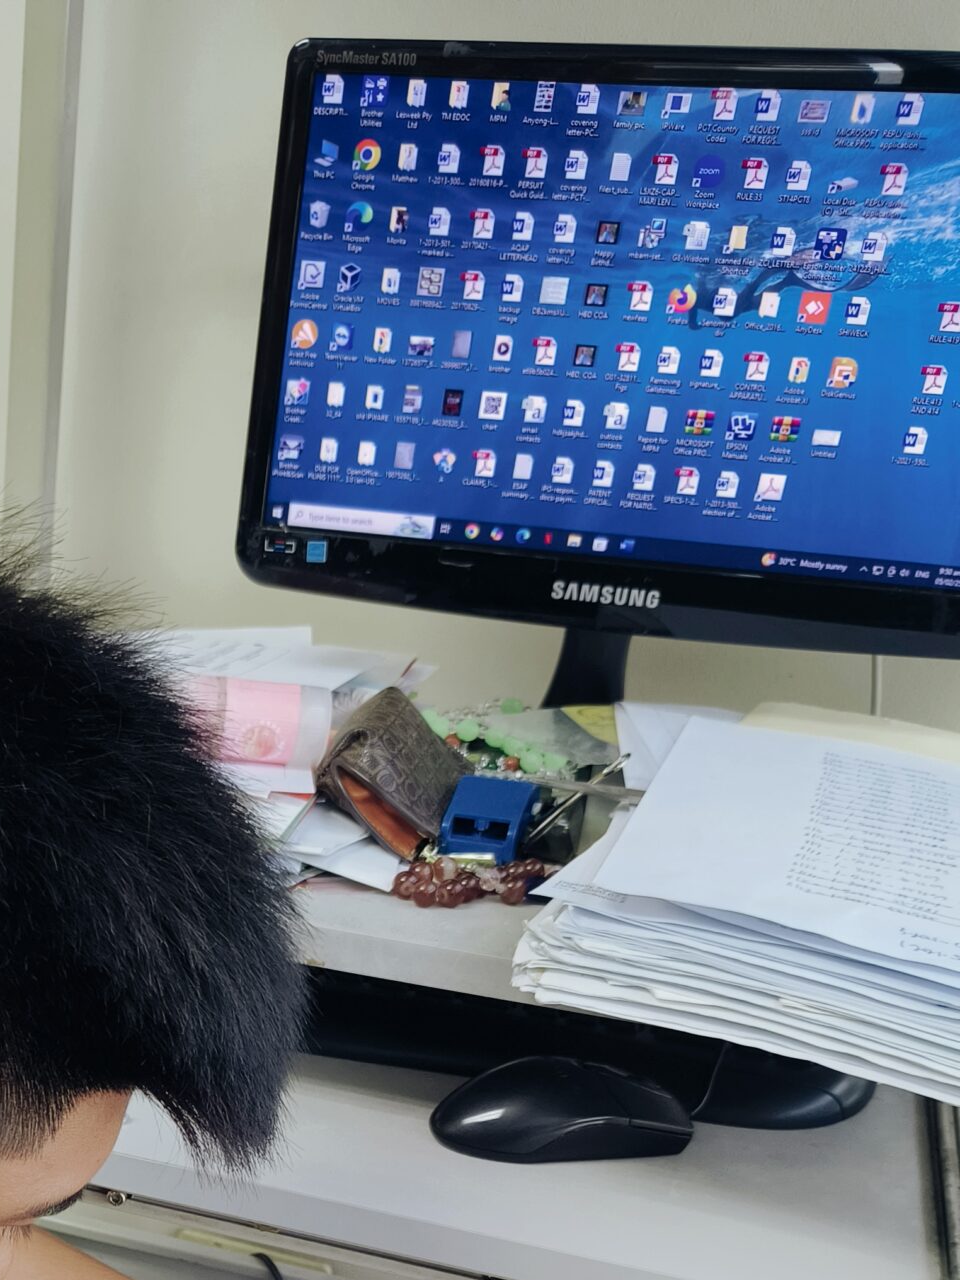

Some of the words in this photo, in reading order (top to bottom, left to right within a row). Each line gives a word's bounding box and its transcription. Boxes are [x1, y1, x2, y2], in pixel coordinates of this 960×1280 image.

[316, 50, 380, 65] SyncMaster
[381, 52, 417, 66] SA100
[361, 109, 383, 118] Brother
[360, 119, 382, 127] Utilities
[490, 115, 508, 123] MPM
[407, 121, 418, 129] Ltd
[571, 120, 598, 129] covering
[353, 173, 375, 182] Google
[351, 183, 375, 191] Chrome
[509, 190, 527, 199] Quick
[694, 190, 715, 199] Zoom
[736, 192, 753, 200] RULE
[685, 200, 720, 210] Workplace
[348, 244, 362, 253] Edge
[802, 262, 823, 272] Epson
[824, 262, 846, 273] Printer
[795, 326, 823, 335] AnyDesk
[929, 334, 947, 343] RULE
[784, 387, 805, 395] Adobe
[821, 389, 856, 399] DiskGenius
[912, 397, 929, 405] RULE
[770, 446, 791, 455] Adobe
[799, 559, 824, 571] Mostly
[825, 562, 847, 573] sunny
[551, 579, 661, 609] SAMSUNG
